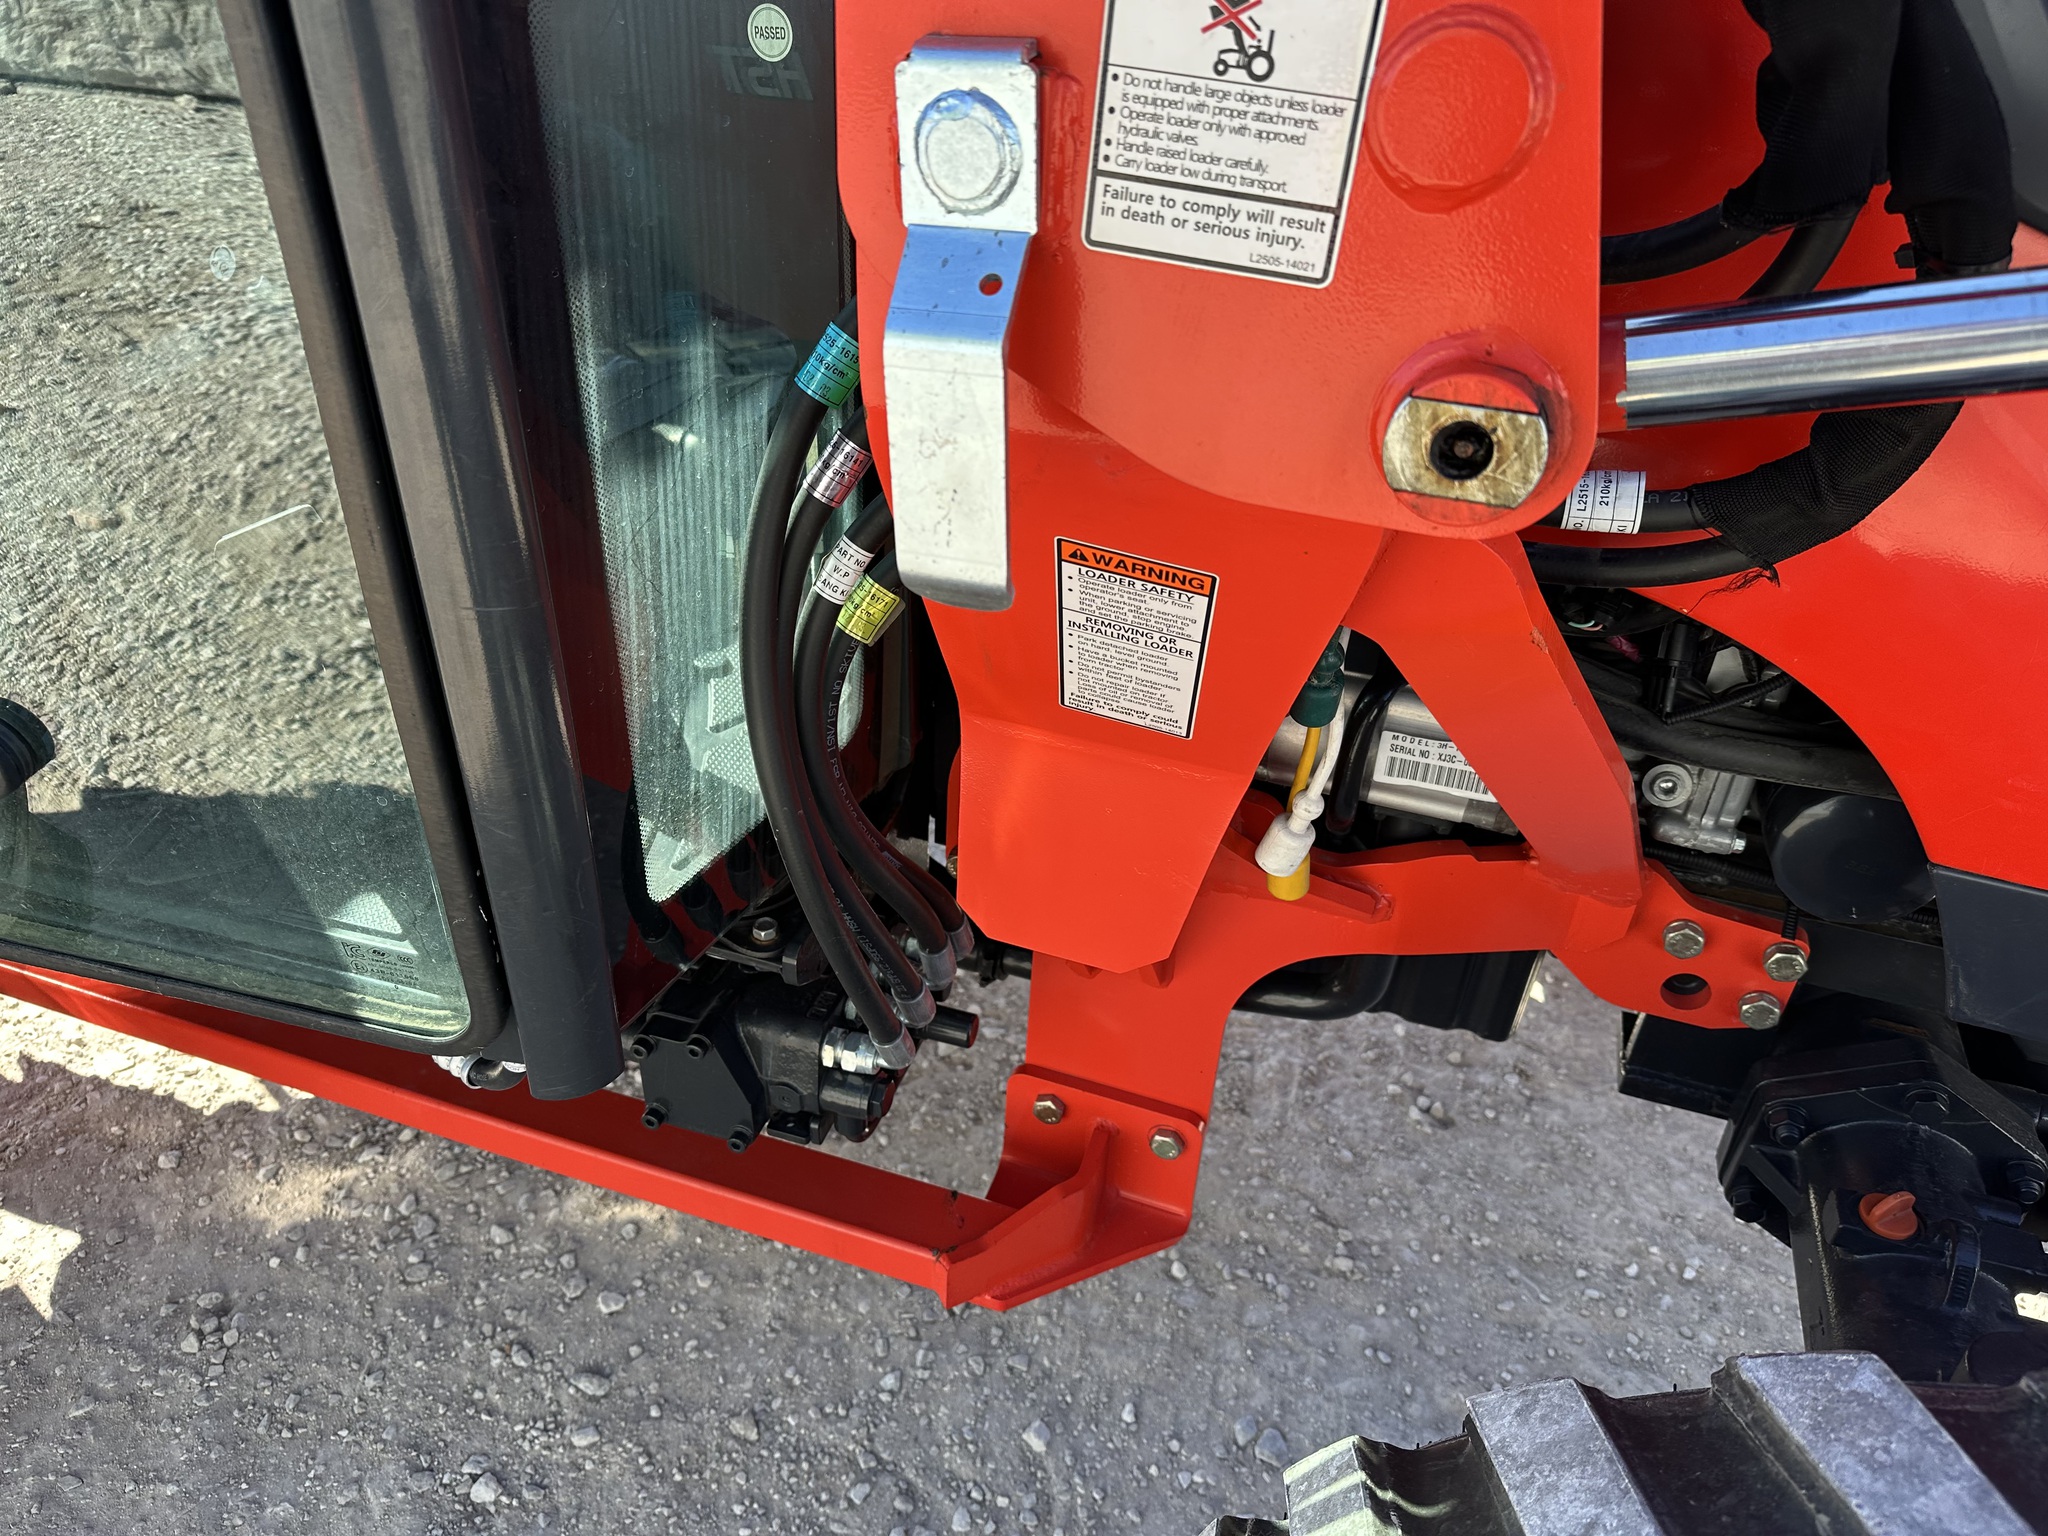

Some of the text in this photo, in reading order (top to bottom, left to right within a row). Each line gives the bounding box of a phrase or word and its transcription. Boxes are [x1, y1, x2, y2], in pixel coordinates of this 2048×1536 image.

[754, 26, 786, 40] PASSED
[1120, 89, 1130, 103] is
[1131, 93, 1184, 111] equipped
[1186, 100, 1210, 114] with
[1211, 105, 1250, 121] proper
[1122, 71, 1346, 117] Do not handle large objects unless loader
[1117, 121, 1164, 141] hydraulic
[1119, 105, 1307, 146] Operate loader only with approved
[1114, 153, 1143, 172] Carry
[1144, 157, 1178, 175] loader
[1179, 163, 1200, 179] low
[1200, 167, 1237, 187] during
[1115, 137, 1268, 175] Handle raised loader carefully.
[1102, 183, 1326, 234] Failure to comply will result
[1100, 200, 1305, 251] in death or serious injury.
[1248, 252, 1315, 272] L2505-14021
[833, 561, 850, 579] W.P
[835, 541, 866, 568] PART NO
[1077, 567, 1194, 602] LOADER SAFETY
[1092, 552, 1205, 591] WARNING
[1077, 577, 1192, 610] Operate loader only from
[1078, 589, 1106, 600] When
[1107, 597, 1142, 610] parking
[1155, 609, 1197, 624] servicing
[1084, 616, 1154, 640] REMOVING
[1100, 600, 1125, 611] lower
[1127, 608, 1178, 624] attachment
[1130, 619, 1164, 632] parking
[1131, 614, 1152, 623] stop
[1067, 619, 1193, 658] INSTALLING LOADER
[1389, 743, 1416, 757] SERIAL
[1418, 749, 1430, 759] NO
